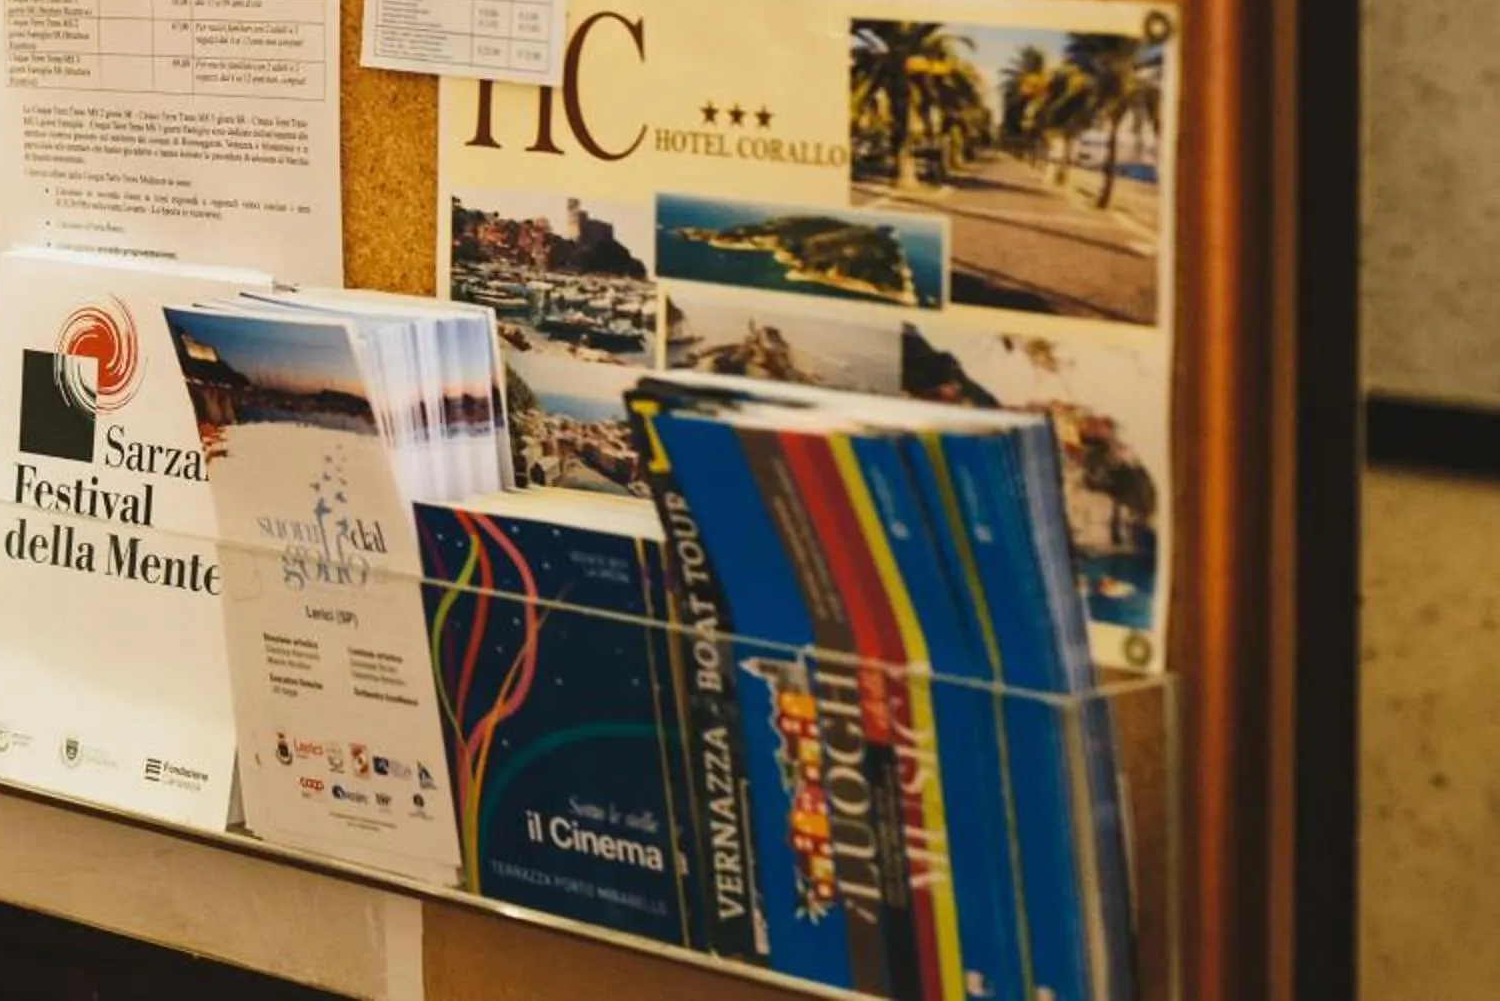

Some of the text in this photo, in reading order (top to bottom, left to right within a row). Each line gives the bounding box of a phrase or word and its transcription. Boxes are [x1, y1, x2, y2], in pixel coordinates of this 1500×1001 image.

[654, 128, 849, 168] HOTEL CORALLO
[105, 423, 210, 483] Sarza
[14, 462, 154, 526] Festival
[4, 518, 222, 597] della Mente
[665, 491, 710, 586] TOUR
[305, 605, 334, 623] Lerici
[689, 593, 723, 692] BOAT
[526, 809, 665, 872] il Cinema
[702, 726, 746, 920] VERNAZZA
